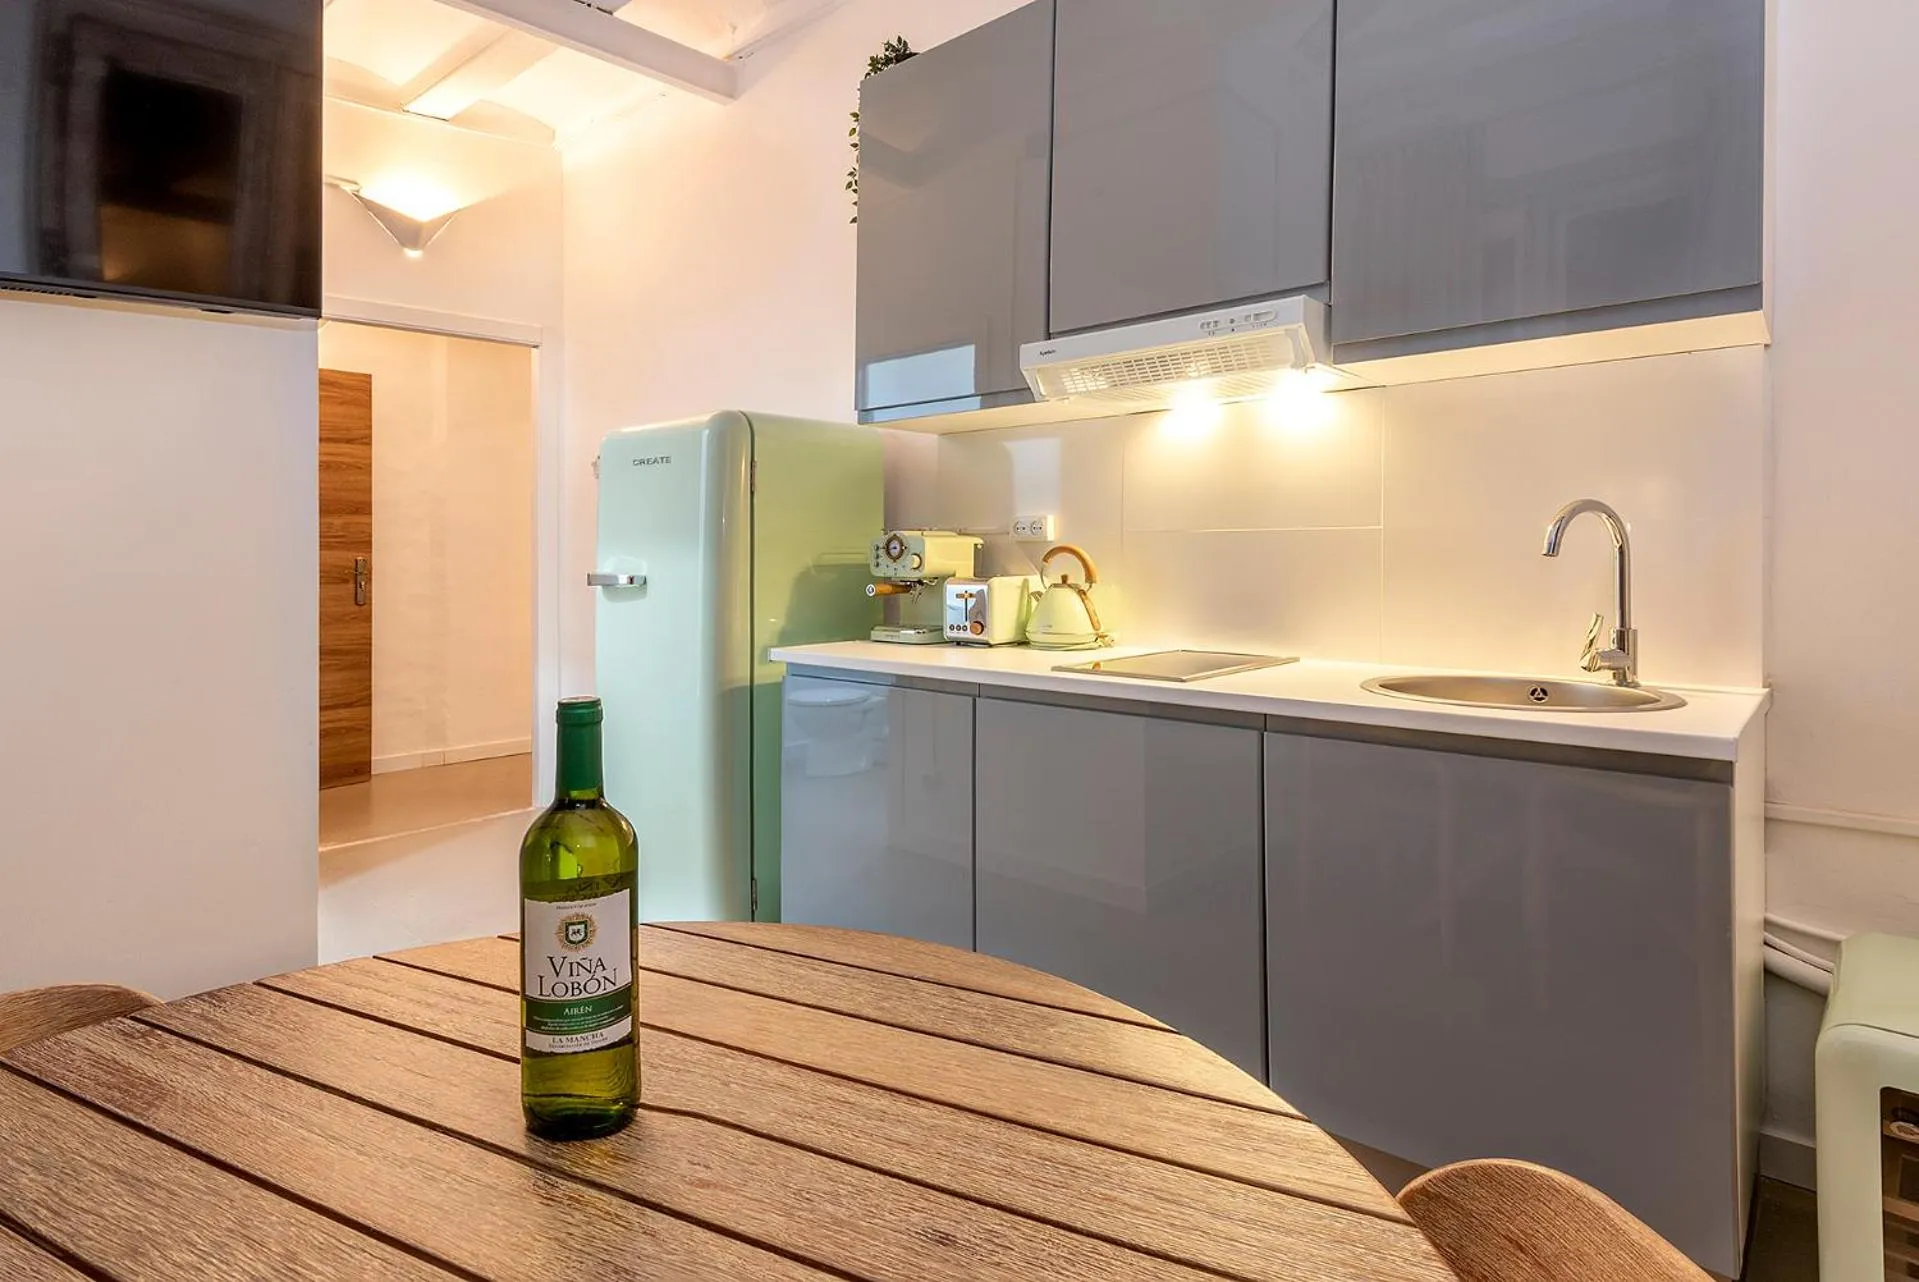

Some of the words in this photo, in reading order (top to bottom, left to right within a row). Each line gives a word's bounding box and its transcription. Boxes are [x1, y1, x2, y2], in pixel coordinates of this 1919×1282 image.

[632, 456, 671, 466] CREATE
[546, 955, 608, 978] VIÑA
[537, 967, 618, 998] LOBÓN
[563, 1005, 593, 1016] AIRÉN
[551, 1036, 564, 1044] LA
[565, 1031, 605, 1044] MANCHA
